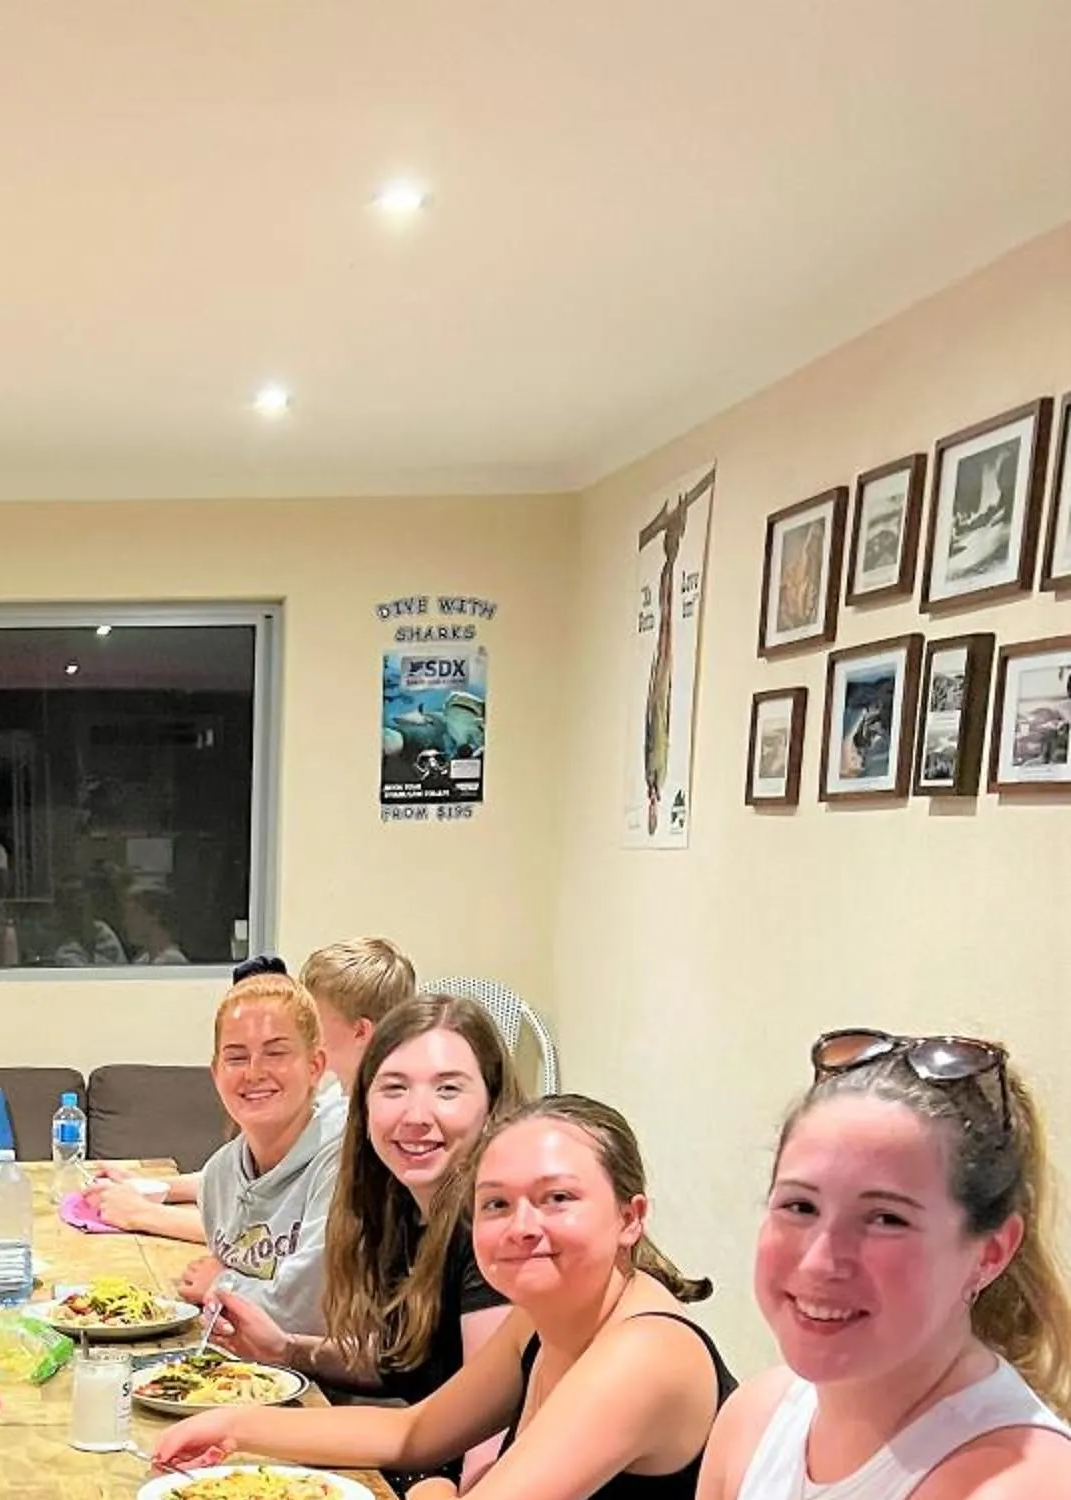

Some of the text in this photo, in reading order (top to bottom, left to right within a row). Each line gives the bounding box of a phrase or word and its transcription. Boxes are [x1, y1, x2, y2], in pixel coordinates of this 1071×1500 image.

[377, 597, 497, 620] DIVE WITH
[394, 625, 476, 643] SHARKS
[381, 804, 428, 822] FROM
